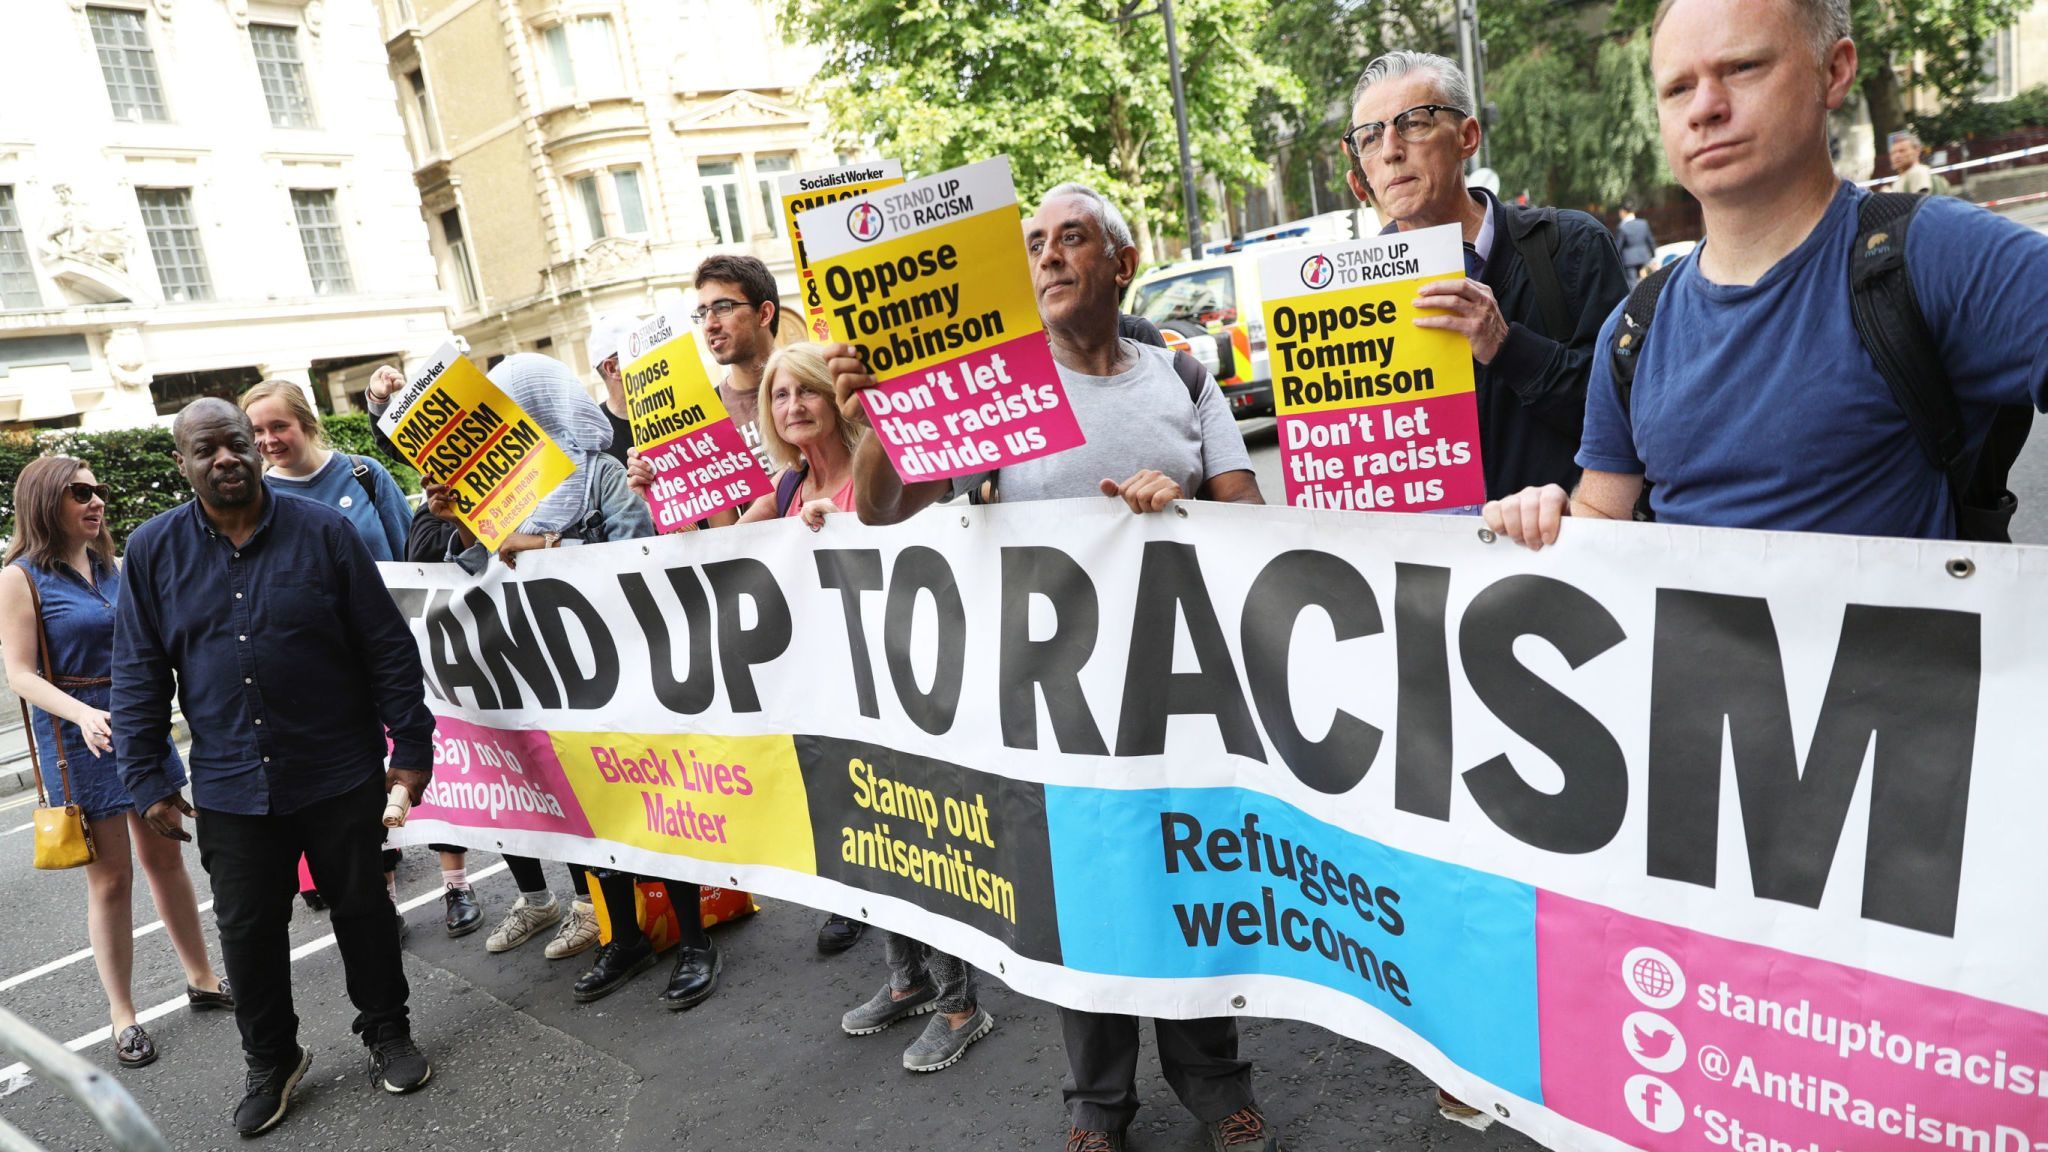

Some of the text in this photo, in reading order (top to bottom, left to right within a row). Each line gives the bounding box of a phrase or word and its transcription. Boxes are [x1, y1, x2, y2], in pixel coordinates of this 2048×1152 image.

[883, 186, 934, 216] STAND
[938, 179, 961, 199] UP
[888, 195, 975, 234] TO RACISM
[824, 244, 959, 306] Oppose
[1336, 243, 1409, 268] STAND UP
[1338, 258, 1420, 284] TO RACISM
[650, 325, 672, 346] RACISM
[656, 315, 667, 329] UP
[833, 282, 960, 341] Tommy
[1273, 299, 1397, 343] Oppose
[625, 359, 670, 397] Oppose
[1276, 336, 1395, 373] Tommy
[629, 385, 676, 421] Tommy
[863, 352, 1012, 417] Don't let
[1281, 366, 1435, 407] Robinson
[397, 387, 461, 459] SMASH
[634, 403, 707, 447] Robinson
[881, 383, 1060, 446] the racists
[1286, 406, 1431, 451] Don't let
[449, 419, 541, 515] & RACISM
[690, 432, 720, 457] let
[899, 426, 1047, 478] divide us
[1289, 441, 1472, 483] the racists
[489, 469, 539, 519] By any means
[650, 474, 687, 502] the
[687, 451, 753, 487] racists
[1295, 478, 1445, 511] divide us
[500, 490, 537, 529] necessary
[659, 479, 752, 527] divide us
[473, 740, 501, 768] no
[494, 741, 524, 775] to
[617, 557, 793, 715] UP
[813, 545, 967, 736] TO
[1000, 540, 1983, 940] RACISM
[590, 746, 754, 796] Black Lives
[640, 791, 728, 844] Matter
[848, 758, 995, 849] Stamp out
[841, 822, 1016, 926] antisemitism
[1161, 812, 1405, 937] Refugees
[1173, 886, 1413, 1007] welcome
[1697, 979, 2048, 1099] standuptoracis
[1697, 1044, 2048, 1152] @AntiRacismD
